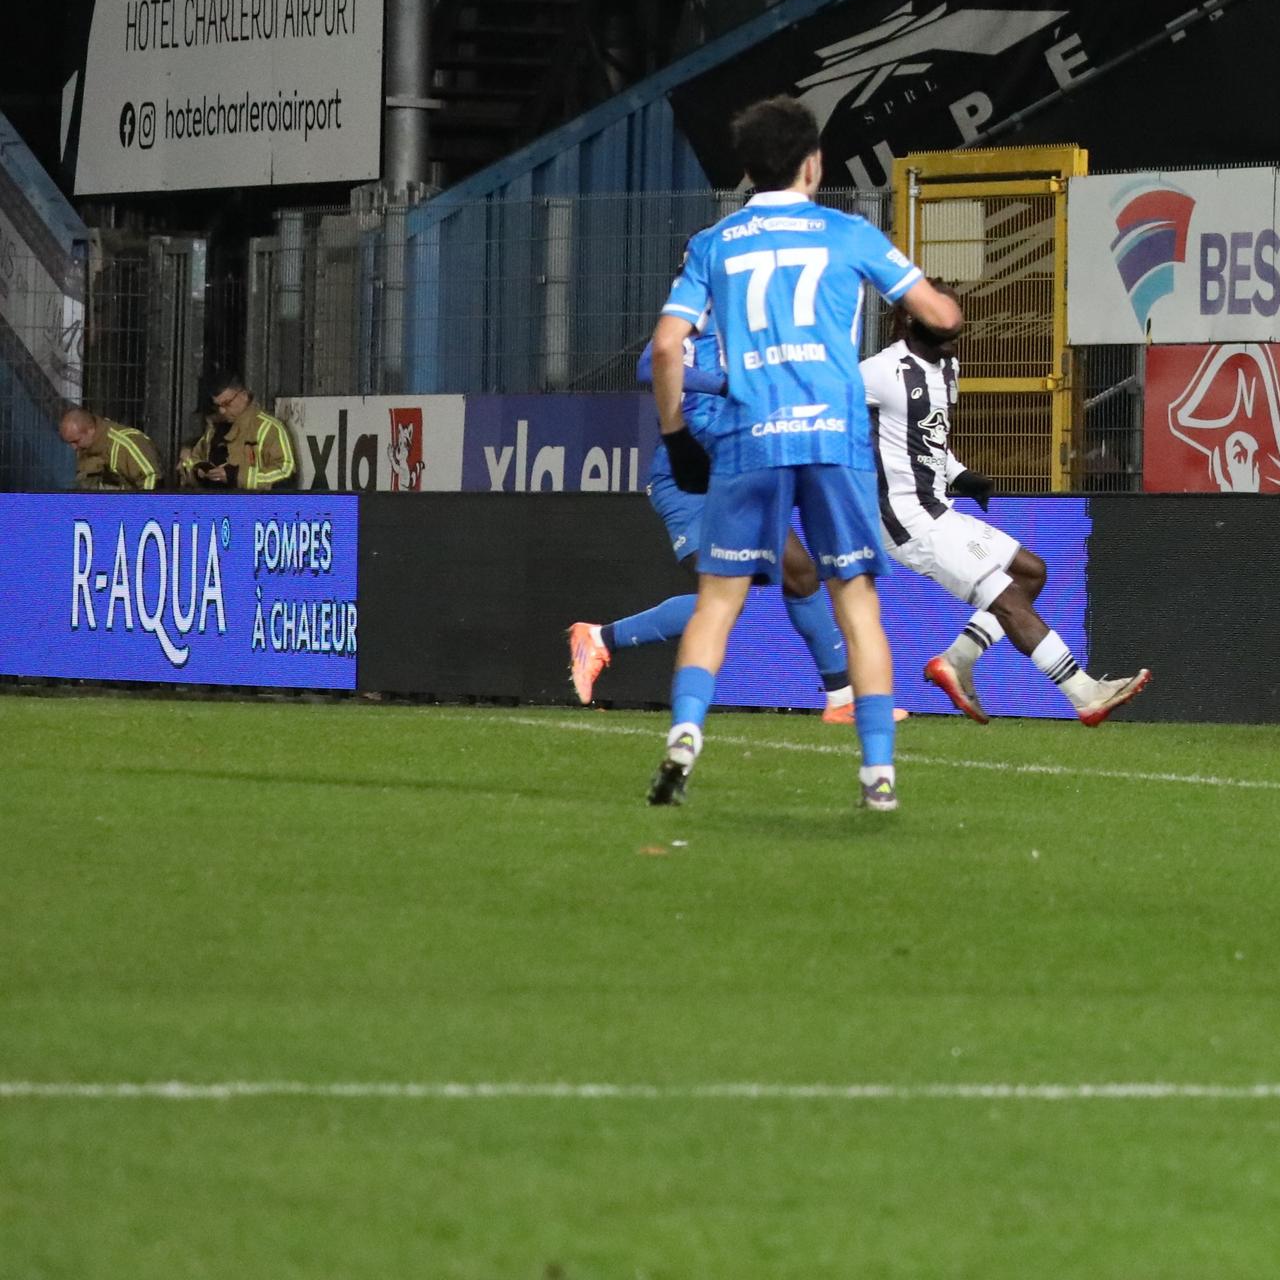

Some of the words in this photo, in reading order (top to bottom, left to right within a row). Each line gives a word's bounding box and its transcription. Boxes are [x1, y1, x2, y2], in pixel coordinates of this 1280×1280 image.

[164, 88, 342, 141] hotelcharleroiairport
[724, 247, 829, 332] 77
[307, 409, 379, 490] xla
[752, 418, 849, 437] CARGLASS
[252, 520, 333, 571] POMPES
[711, 543, 777, 564] immoweb
[252, 587, 267, 651] À
[271, 600, 358, 655] CHALEUR
